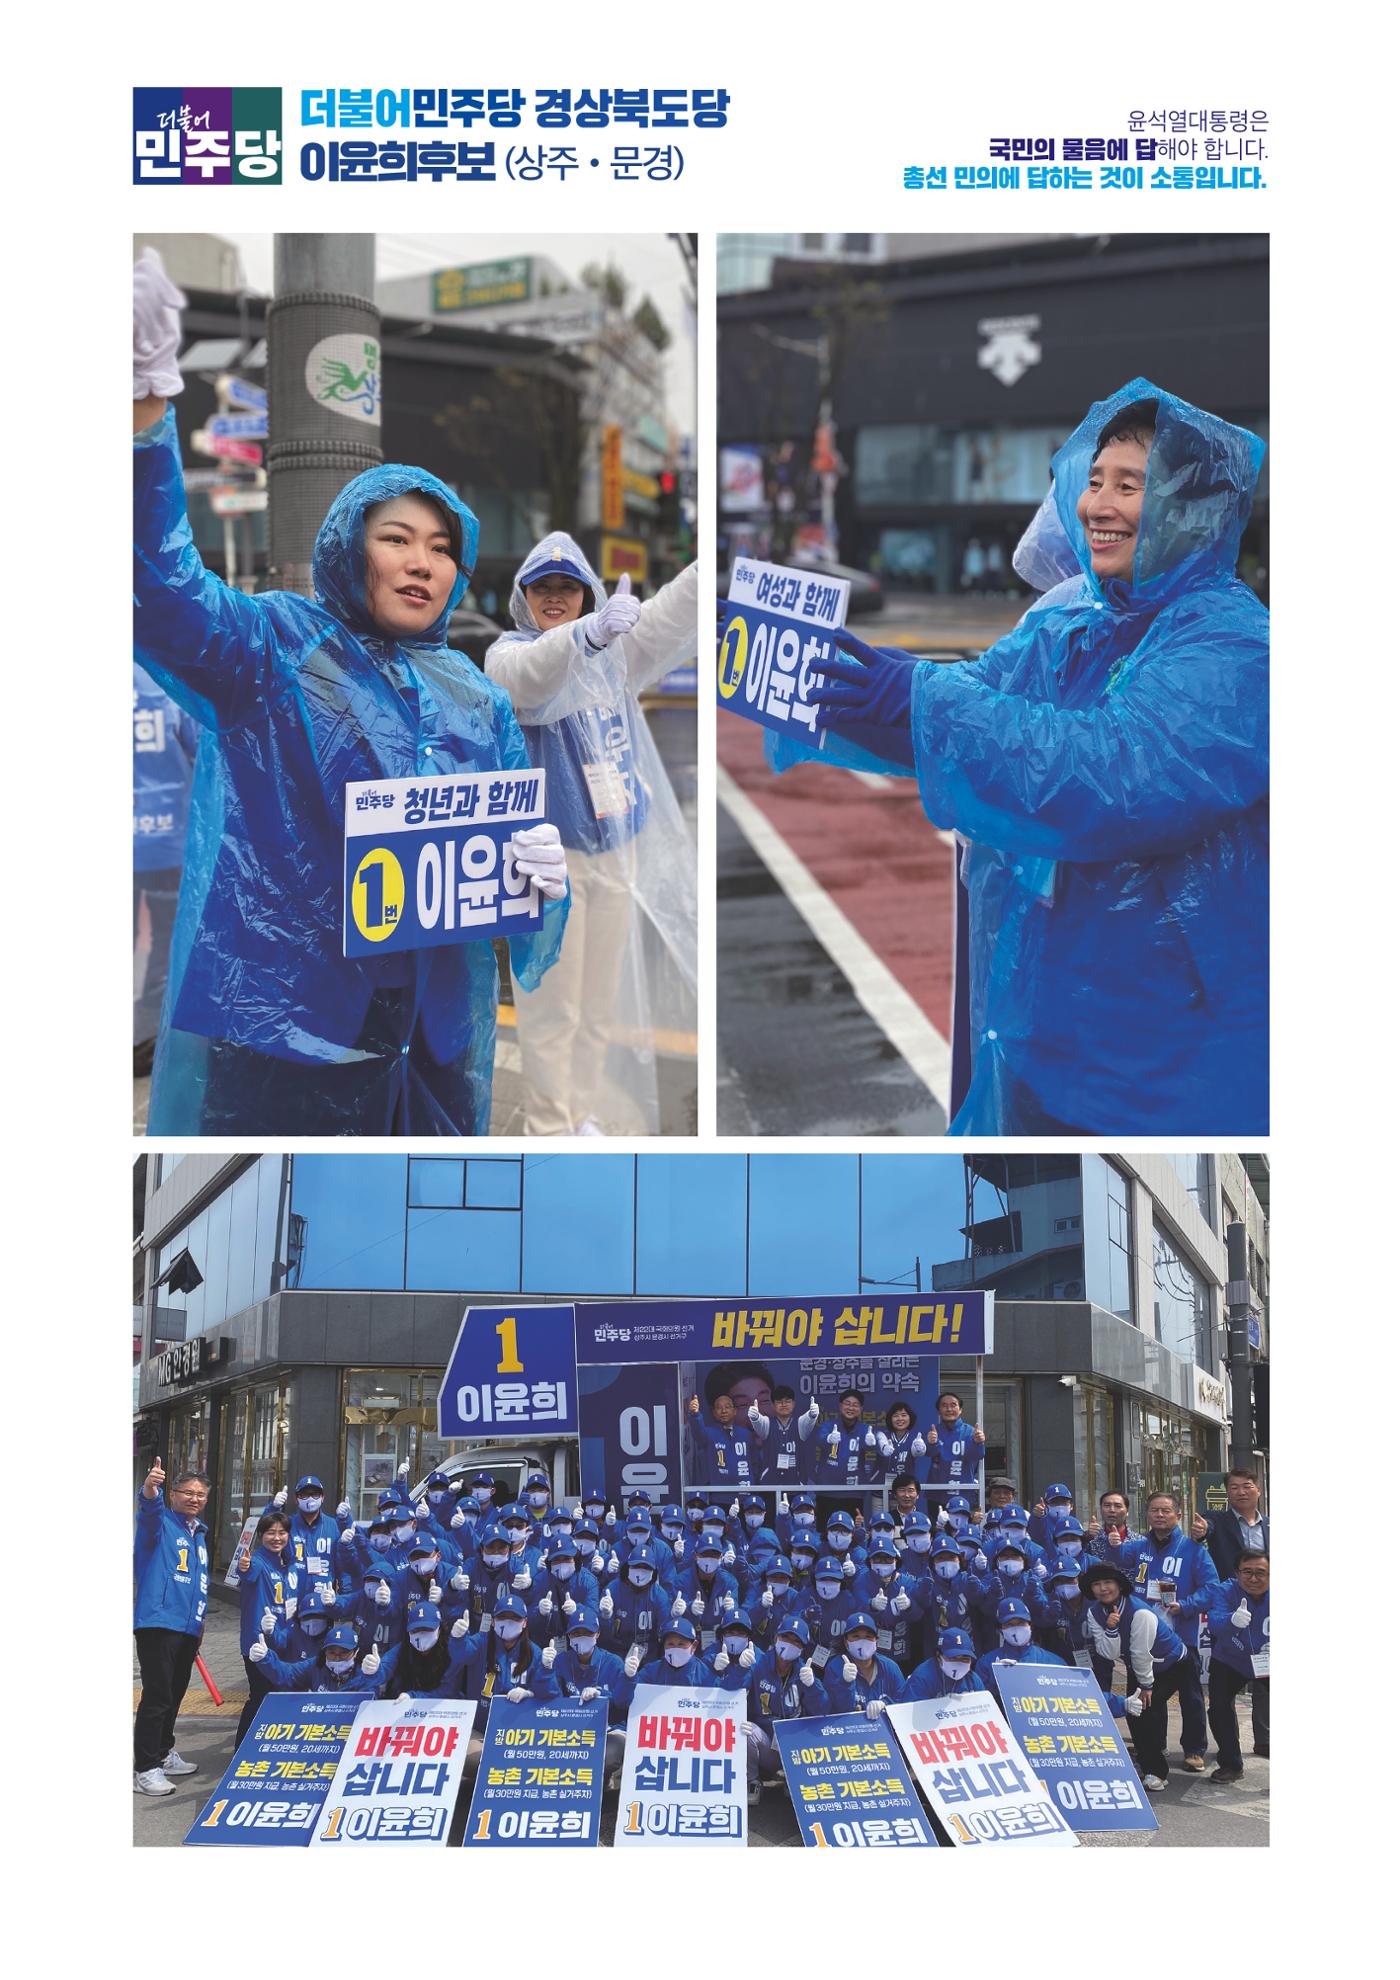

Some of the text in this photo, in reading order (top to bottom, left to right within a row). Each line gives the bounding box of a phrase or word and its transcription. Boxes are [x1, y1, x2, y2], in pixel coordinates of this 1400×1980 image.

[756, 572, 840, 622] 여성과 함께
[355, 794, 396, 811] 민주당
[403, 778, 539, 823] 청년과 함께
[594, 1328, 631, 1342] 민주당
[711, 1303, 964, 1349] 바꿔야 삽니다!
[495, 1317, 524, 1374] 1
[158, 1353, 171, 1385] MG
[800, 1372, 920, 1394] 이윤희의 약속
[456, 1381, 567, 1423] 이윤희
[176, 1549, 189, 1573] 1
[294, 1543, 304, 1562] 1
[1135, 1562, 1147, 1583] 1
[274, 1581, 285, 1604] 1
[481, 1672, 496, 1698] 1
[535, 1708, 559, 1718] 민주당
[1021, 1696, 1049, 1714] 아기
[1050, 1697, 1104, 1715] 기본소득
[265, 1724, 294, 1741] 아기
[294, 1724, 353, 1742] 기본소득
[354, 1725, 458, 1758] 바꿔야
[505, 1729, 535, 1746] 아기
[537, 1729, 596, 1747] 기본소득
[637, 1715, 736, 1753] 바꿔야
[909, 1720, 1010, 1766] 바꿔야
[1023, 1735, 1120, 1754] 농촌 기본소득
[801, 1747, 833, 1765] 아기
[834, 1743, 891, 1762] 기본소득
[234, 1760, 338, 1780] 농촌 기본소득
[342, 1762, 450, 1797] 삽니다
[487, 1767, 593, 1786] 농촌 기본소득
[634, 1755, 736, 1794] 삽니다
[932, 1758, 1031, 1804] 삽니다
[799, 1778, 905, 1801] 농촌 기본소득
[1056, 1779, 1143, 1811] 이윤희
[201, 1799, 321, 1829] 1 이윤희
[346, 1806, 449, 1840] 이윤희
[472, 1809, 592, 1840] 1 이윤희
[646, 1803, 742, 1839] 이윤희
[972, 1801, 1069, 1841] 이윤희
[809, 1818, 926, 1847] 1 이윤희
